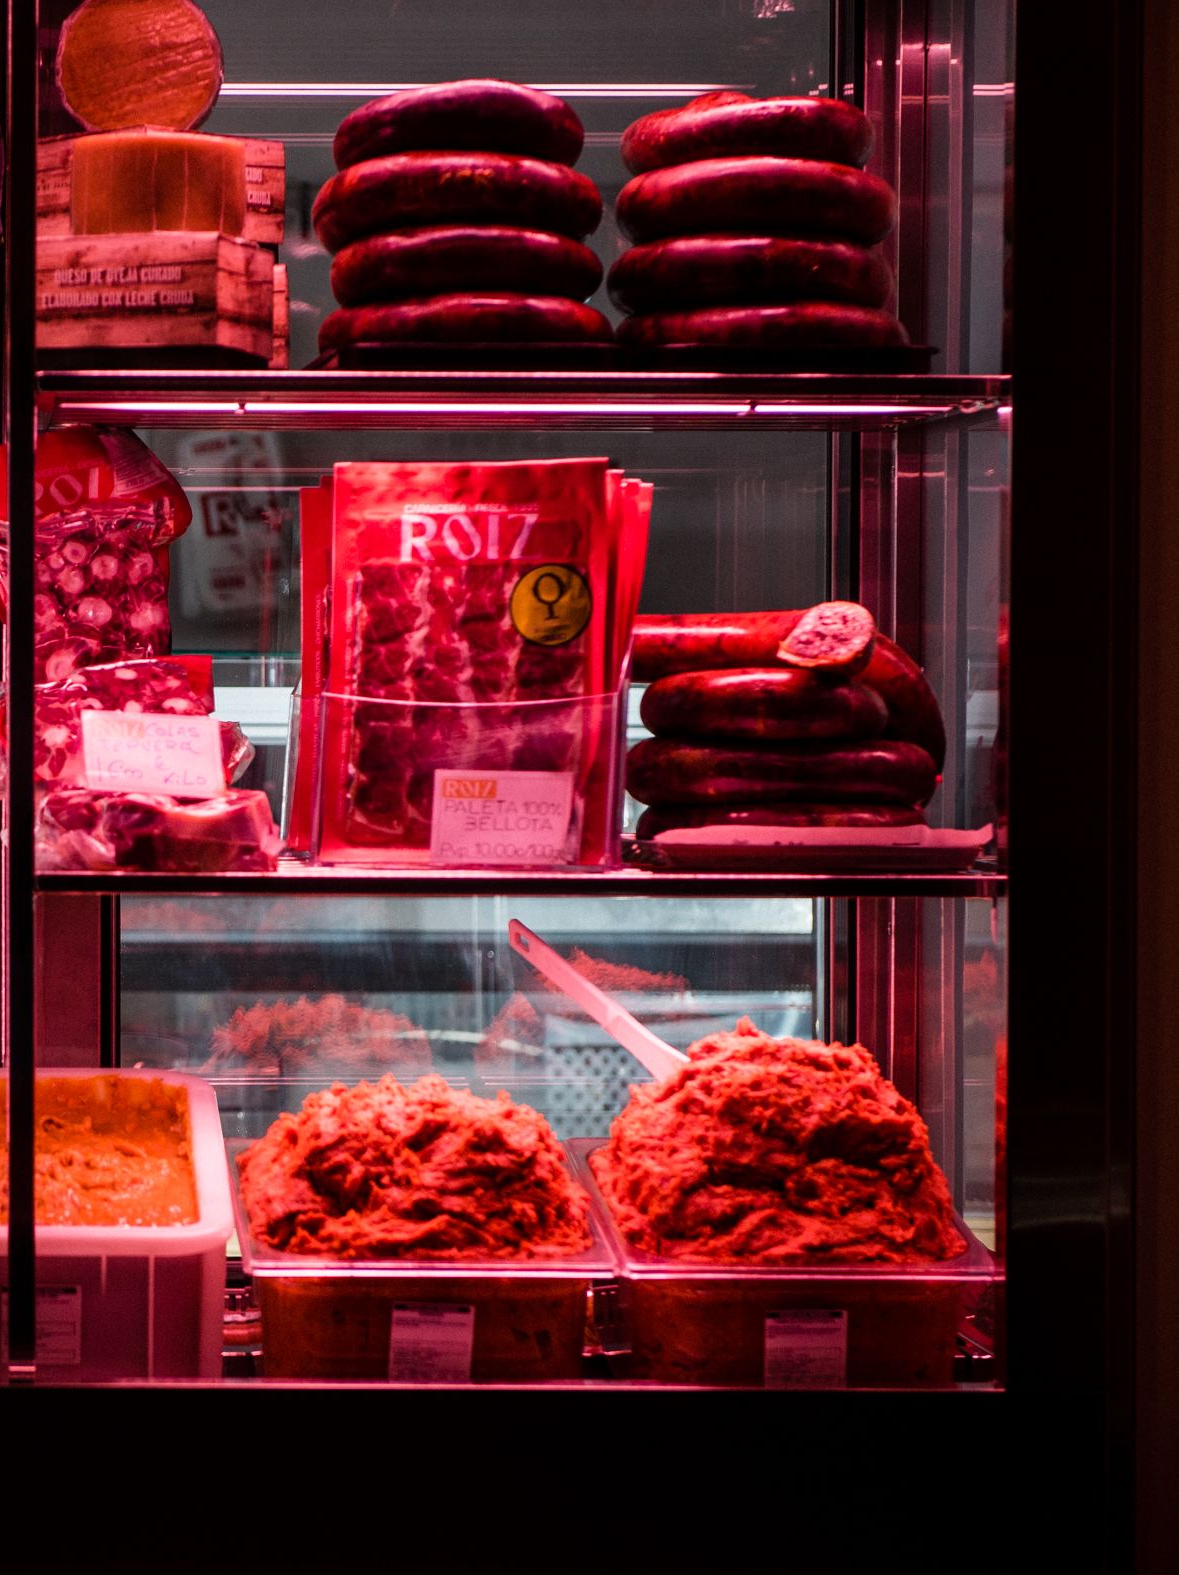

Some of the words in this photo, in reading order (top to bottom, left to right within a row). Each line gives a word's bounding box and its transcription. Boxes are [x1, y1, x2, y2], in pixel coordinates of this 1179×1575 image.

[54, 268, 87, 283] QUESO
[90, 267, 103, 282] DE
[105, 267, 137, 282] OVEJA
[140, 266, 181, 282] CURADO
[42, 292, 99, 308] ELABORADO
[101, 291, 122, 306] CON
[125, 290, 156, 306] LECHE
[160, 289, 194, 305] CRUDA
[399, 513, 542, 563] ROIZ
[445, 780, 493, 798] ROIZ
[444, 800, 518, 815] PALETA
[522, 801, 562, 816] 100%
[464, 817, 553, 831] BELLOTA
